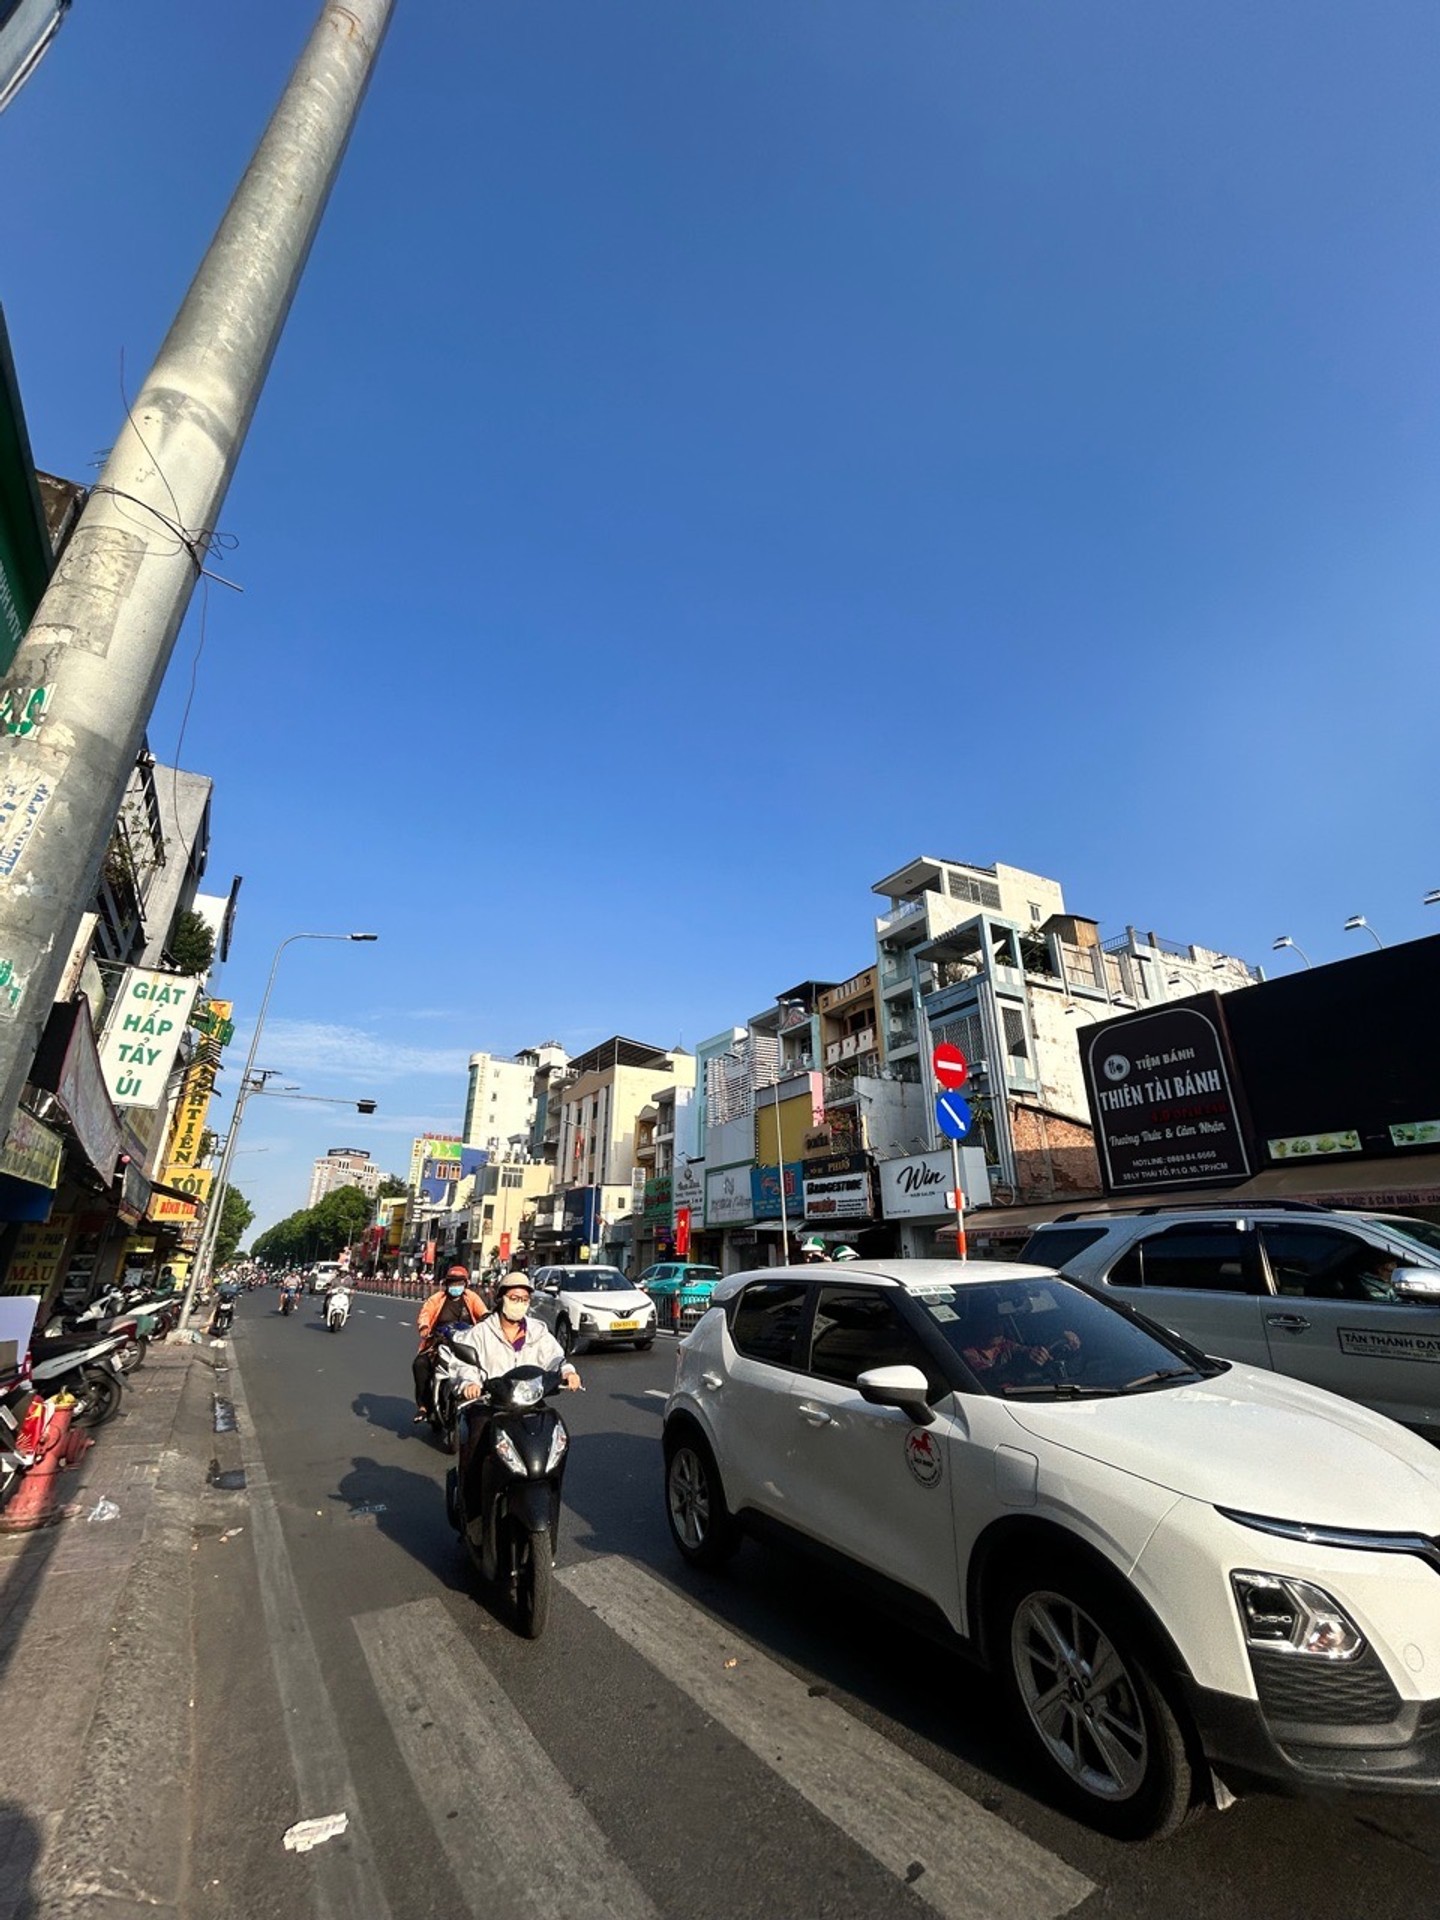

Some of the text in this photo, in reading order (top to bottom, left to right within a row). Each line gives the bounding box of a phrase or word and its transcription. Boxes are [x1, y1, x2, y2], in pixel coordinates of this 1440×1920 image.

[132, 982, 186, 1007] GIẶT
[122, 1010, 173, 1036] HẤP
[118, 1037, 163, 1065] TẨY
[1135, 1048, 1195, 1070] TIỆM BÁNH
[115, 1069, 142, 1097] ỦI
[1100, 1069, 1221, 1111] THIÊN TÀI BÁNH
[1165, 1128, 1173, 1138] &
[171, 1173, 205, 1194] XÔI
[896, 1161, 946, 1193] Win
[8, 1261, 55, 1281] MÀU
[1344, 1332, 1367, 1344] TÂN
